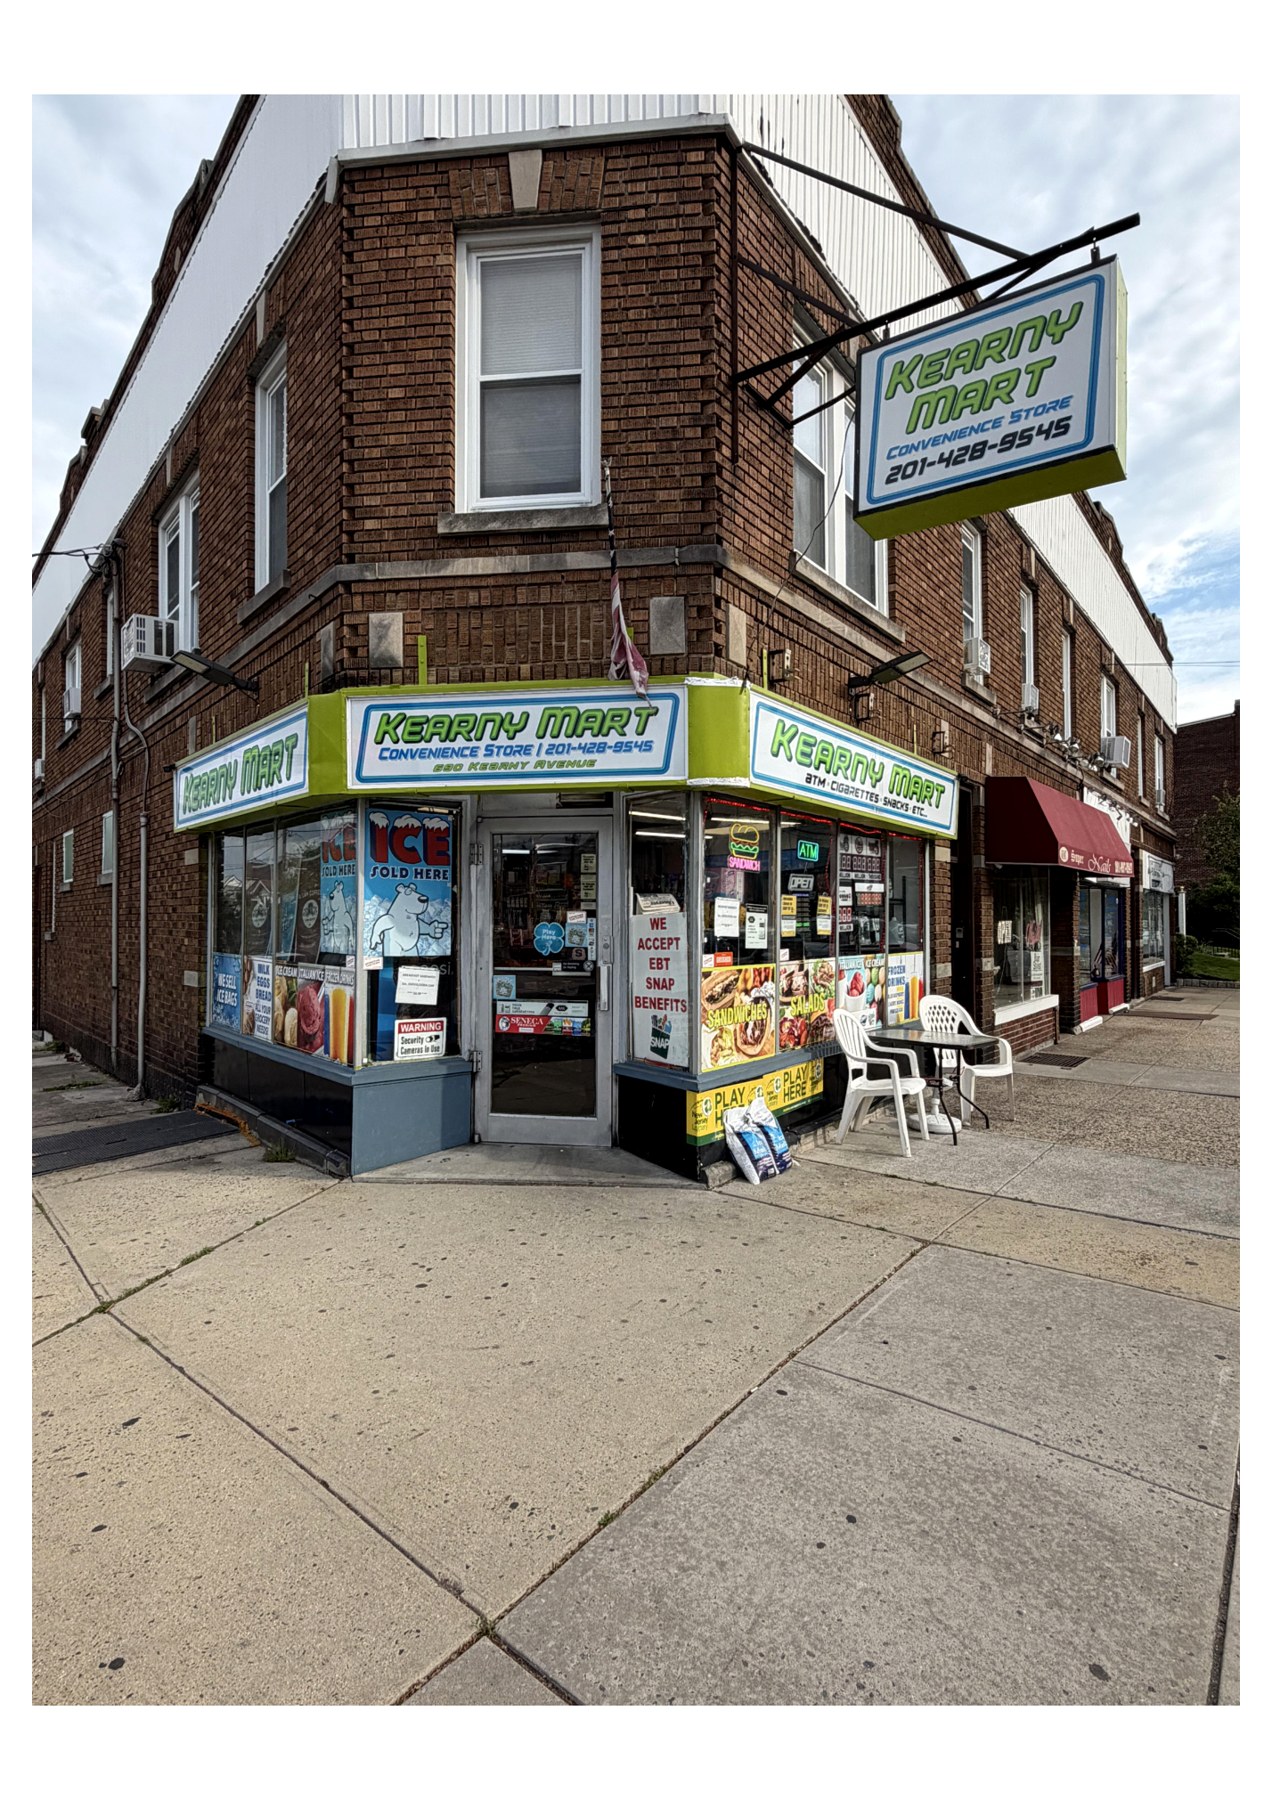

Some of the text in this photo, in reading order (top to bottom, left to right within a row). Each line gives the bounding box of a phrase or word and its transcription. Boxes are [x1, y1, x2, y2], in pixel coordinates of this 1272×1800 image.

[885, 301, 1084, 400] KEARNY
[905, 355, 1056, 435] MART
[885, 395, 1073, 461] CONVENIENCE STORE
[885, 415, 1072, 485] 201-428-9545
[374, 706, 659, 745] KEARNY MART
[378, 745, 478, 762] CONVENIENCE
[483, 743, 532, 758] STORE
[545, 740, 654, 756] 201-428-9545
[534, 759, 597, 769] AVENUE
[770, 718, 946, 809] KEARNY MART
[183, 732, 298, 815] KEARNY MART
[369, 812, 450, 866] ICE
[800, 843, 817, 858] ATM
[322, 864, 356, 877] SOLD HERE
[728, 856, 760, 872] SANDWICH
[1088, 853, 1111, 873] Nails
[370, 866, 449, 880] SOLD HERE
[791, 878, 813, 889] OPEN
[649, 917, 667, 930] WE
[637, 937, 681, 951] ACCEPT
[257, 963, 270, 975] MILK
[649, 957, 670, 971] EBT
[888, 965, 906, 976] FROZEN
[218, 973, 237, 989] WE SELL
[257, 977, 271, 988] EGGS
[646, 977, 675, 991] SNAP
[256, 989, 271, 1001] BREAD
[634, 996, 687, 1013] BENEFITS
[790, 993, 825, 1017] SALADS
[511, 1017, 544, 1025] SENECA
[707, 1003, 768, 1028] SANDWICHES
[400, 1022, 441, 1032] WARNING
[401, 1035, 424, 1045] Security
[650, 1035, 671, 1050] SNAP
[401, 1046, 423, 1055] Cameras
[430, 1045, 440, 1053] Use
[783, 1064, 807, 1087] PLAY
[714, 1087, 746, 1109] PLAY
[783, 1081, 807, 1103] HERE
